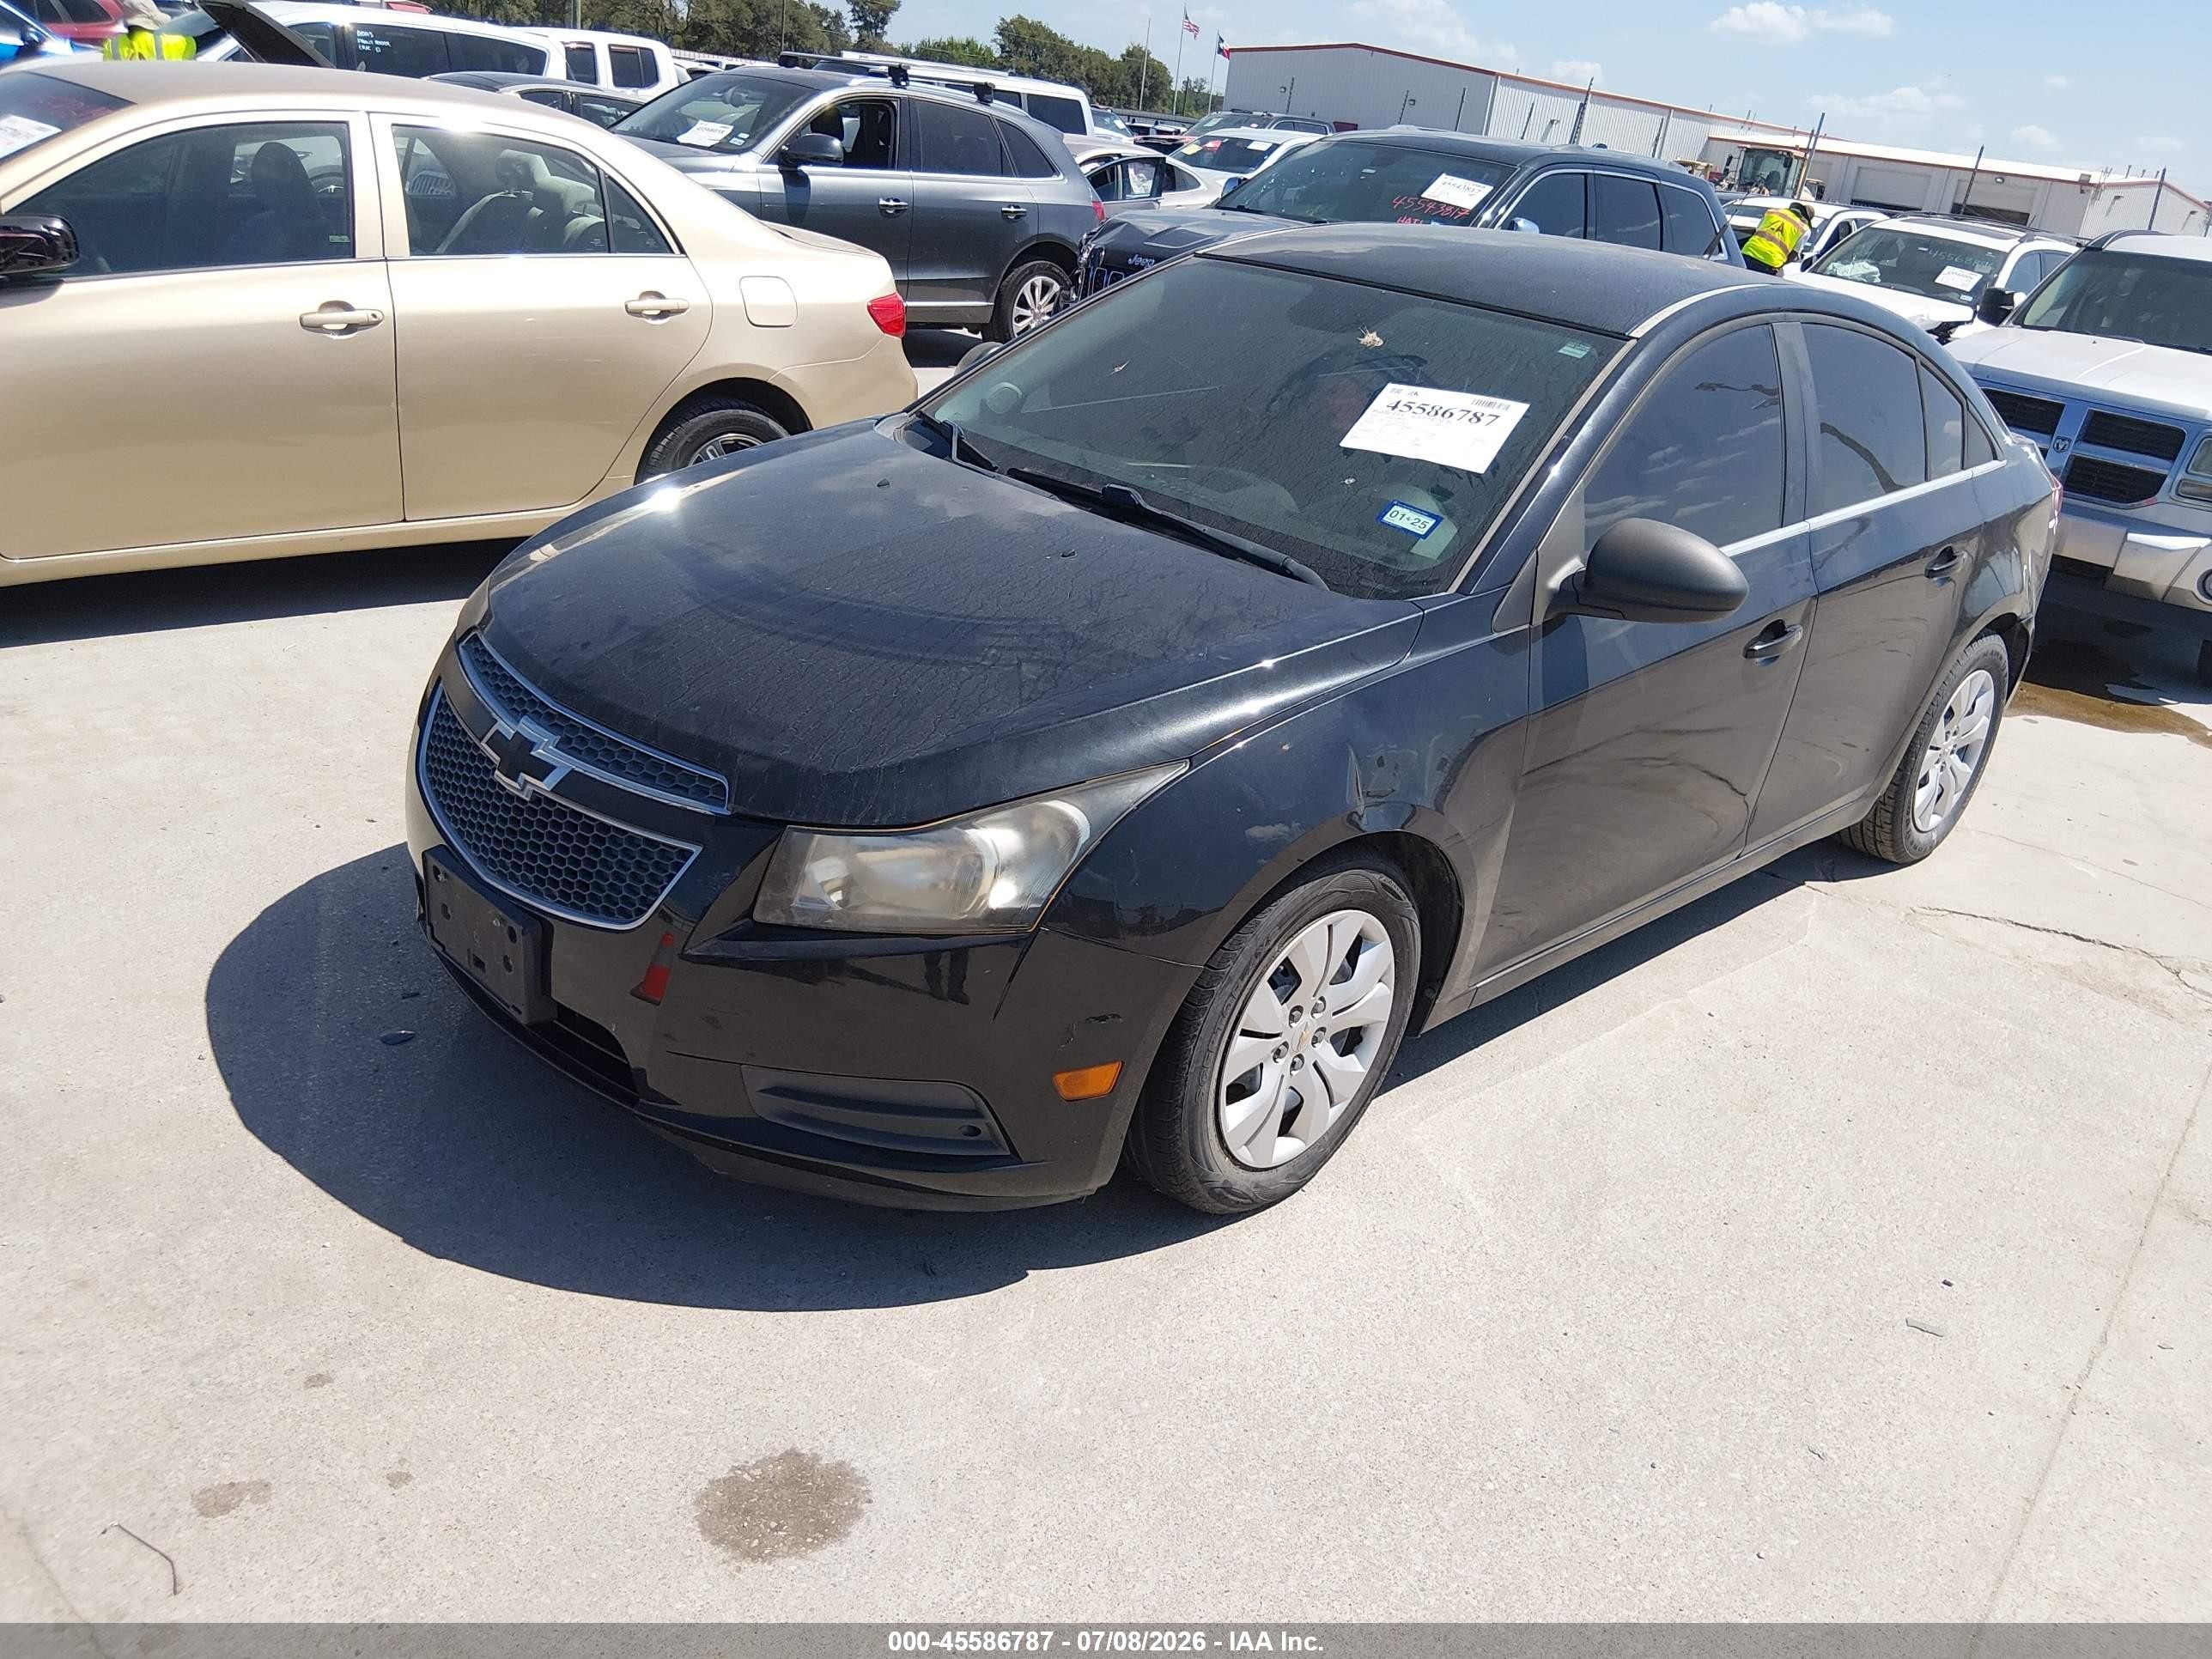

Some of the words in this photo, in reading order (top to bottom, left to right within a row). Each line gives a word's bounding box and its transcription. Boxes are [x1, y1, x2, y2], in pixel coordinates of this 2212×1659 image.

[1392, 196, 1471, 220] 45543817
[1127, 254, 1156, 270] Jeep
[1386, 399, 1501, 427] 45586787
